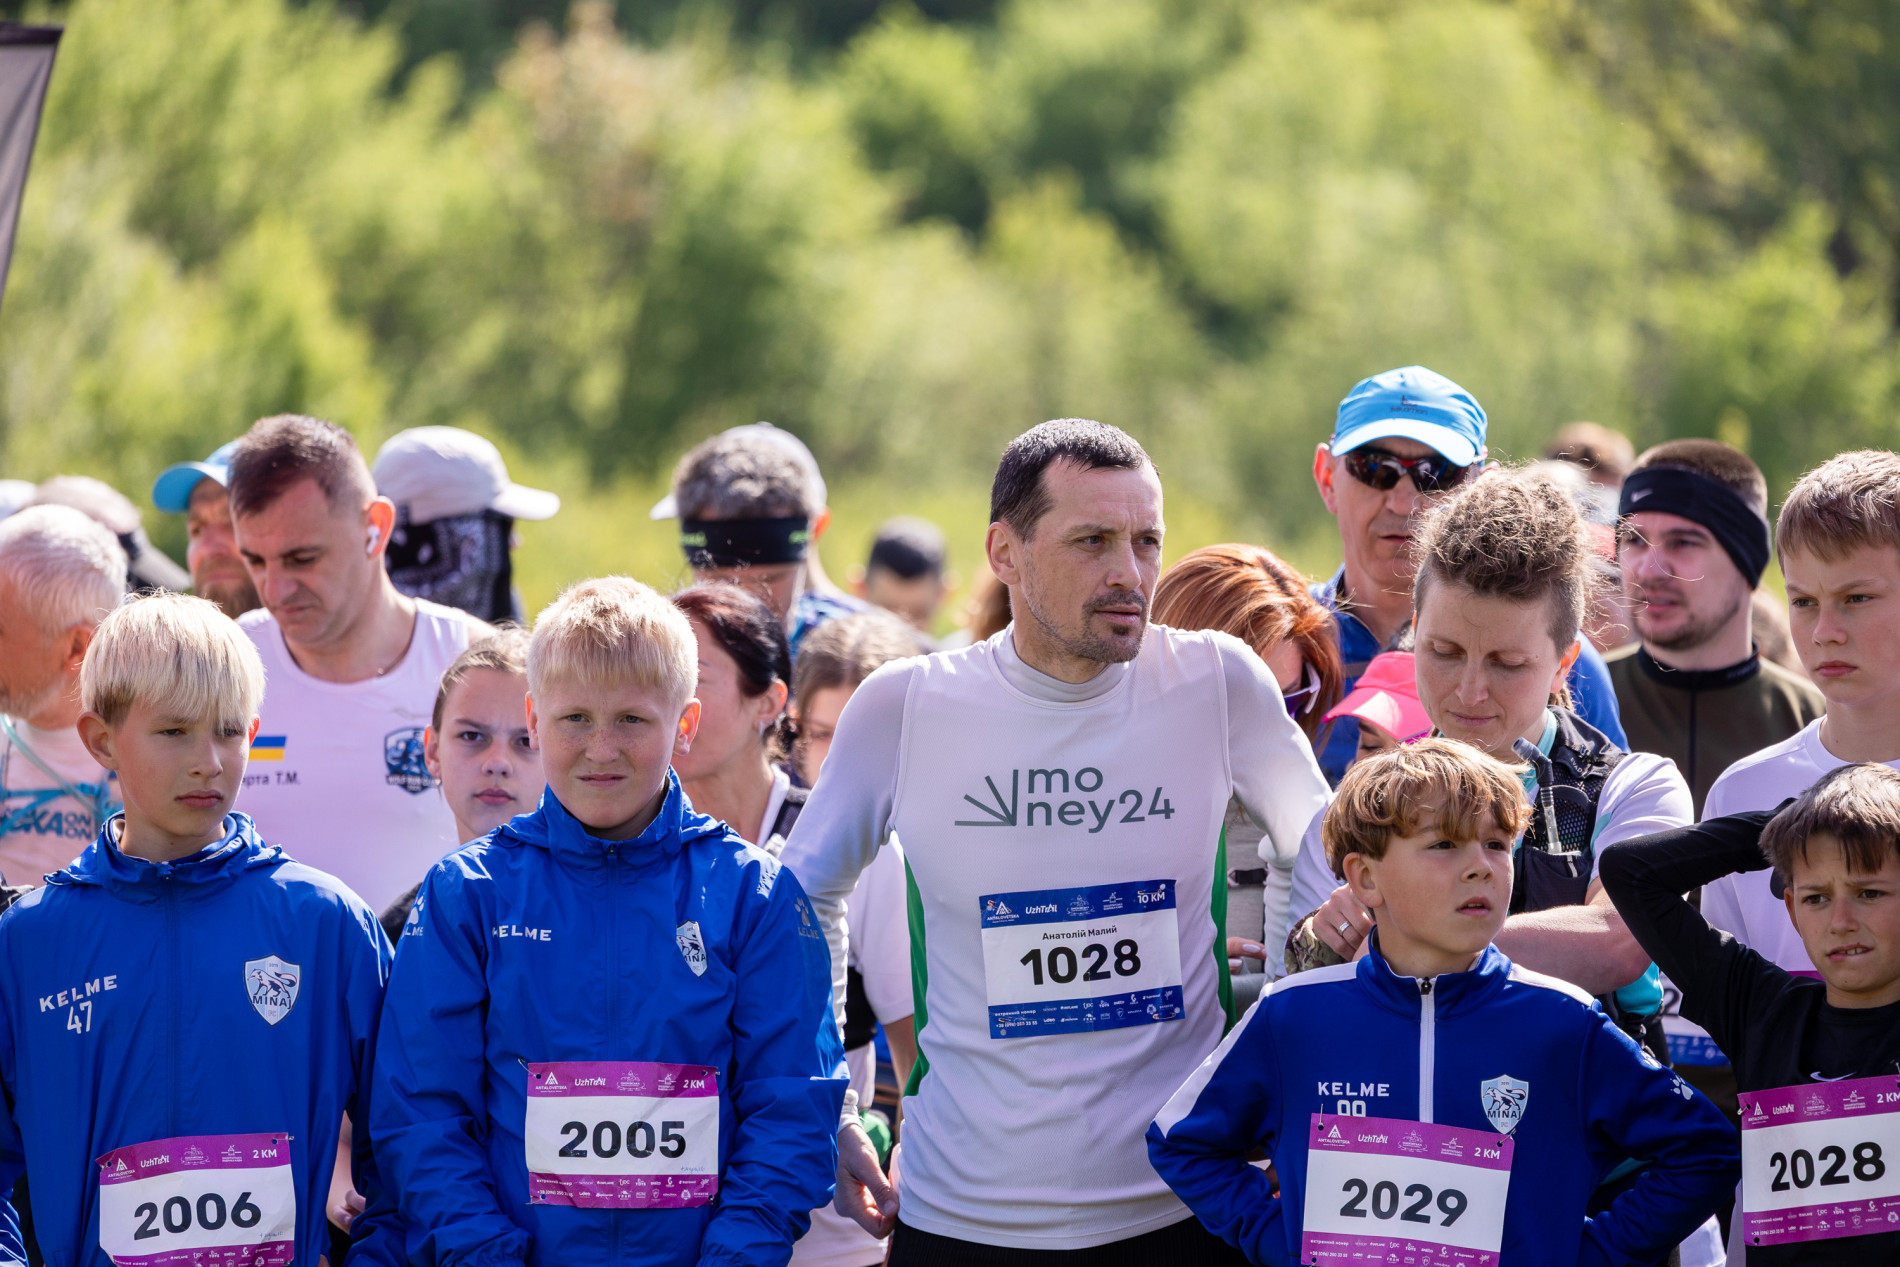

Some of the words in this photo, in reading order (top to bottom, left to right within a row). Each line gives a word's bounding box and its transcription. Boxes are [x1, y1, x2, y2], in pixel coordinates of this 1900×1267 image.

[1028, 767, 1104, 794] mo
[1027, 787, 1175, 834] ney24
[1137, 894, 1149, 905] 10
[1042, 929, 1087, 941] Анатолій
[1088, 925, 1118, 937] Малий
[1020, 939, 1141, 985] 1028
[39, 974, 118, 1013] KELME
[252, 995, 292, 1010] MINAJ
[66, 1000, 93, 1034] 47
[682, 1079, 689, 1089] 2
[690, 1080, 705, 1089] KM
[1318, 1081, 1390, 1097] KELME
[1877, 1093, 1884, 1103] 2
[1487, 1110, 1521, 1121] MINAJ
[559, 1121, 686, 1158] 2005
[252, 1150, 260, 1159] 2
[261, 1149, 278, 1159] KM
[1474, 1147, 1481, 1157] 2
[1483, 1148, 1501, 1160] KM
[1770, 1141, 1886, 1192] 2028
[1339, 1178, 1468, 1227] 2029
[134, 1192, 262, 1240] 2006
